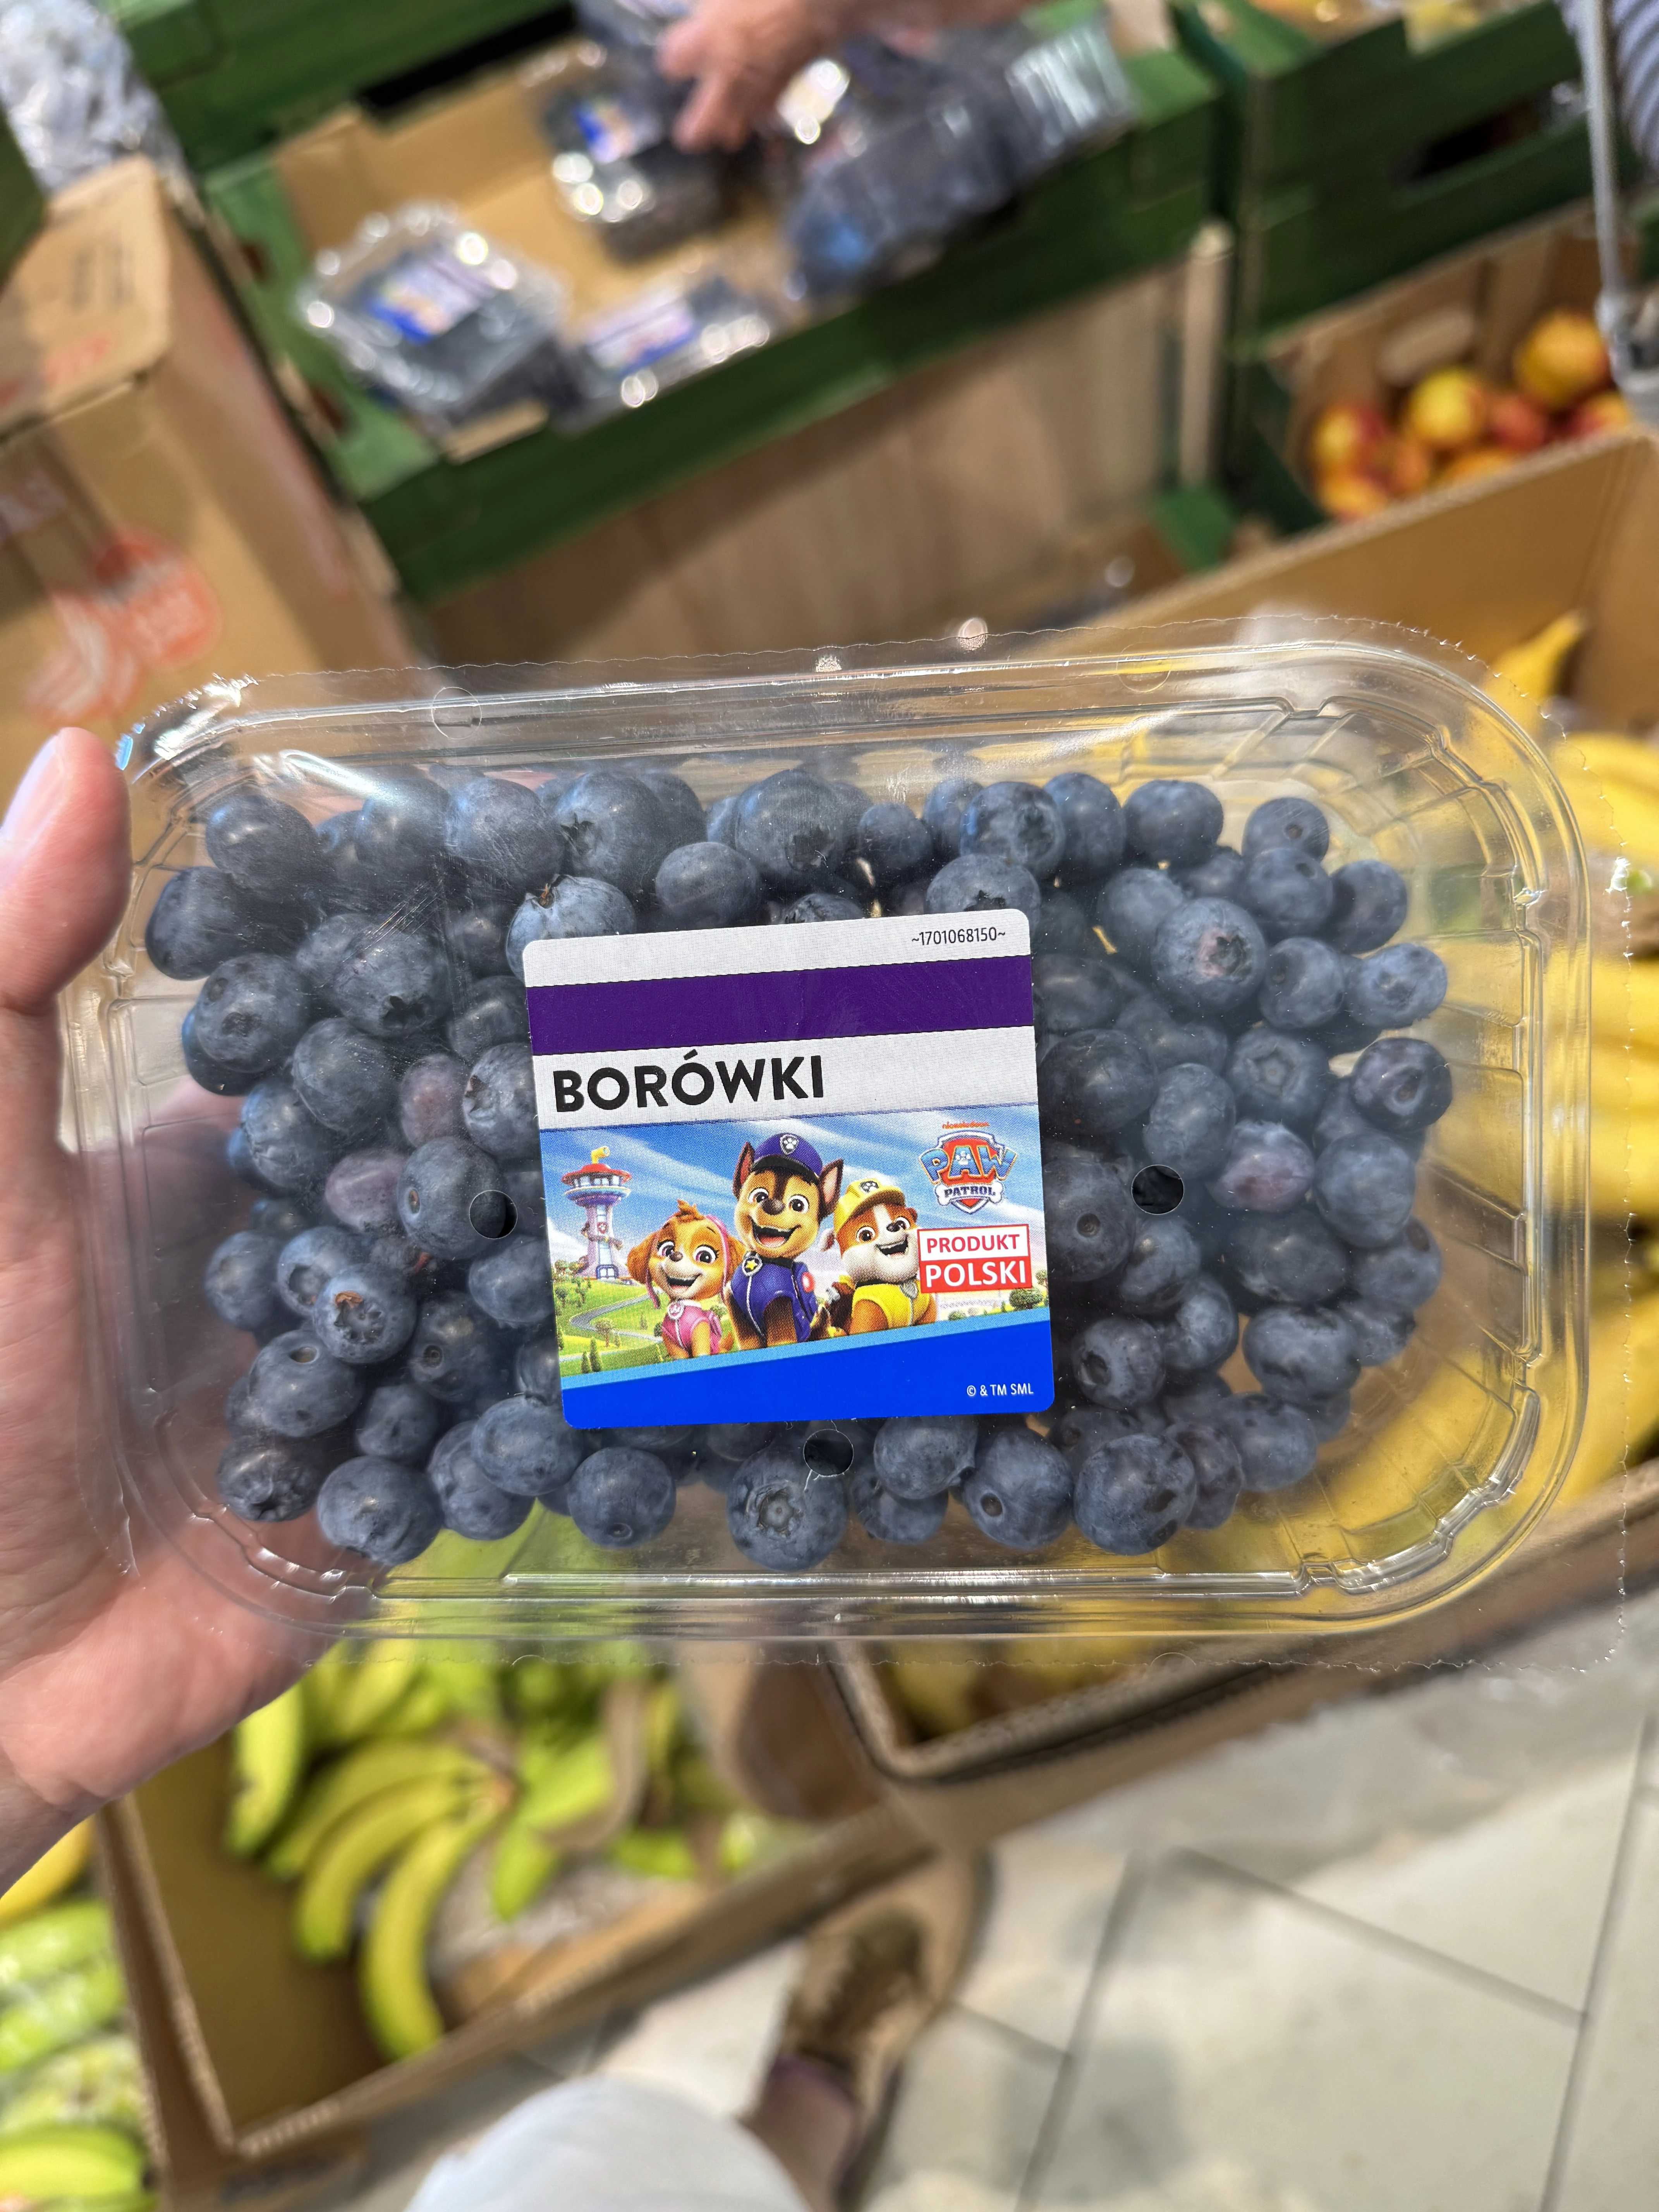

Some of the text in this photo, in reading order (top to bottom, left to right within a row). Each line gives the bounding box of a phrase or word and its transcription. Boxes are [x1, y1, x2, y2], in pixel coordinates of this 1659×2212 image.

[912, 927, 1005, 945] ~1701068150~
[553, 1049, 823, 1112] BORÓWKI
[919, 1145, 1018, 1185] PAW
[944, 1186, 996, 1197] PATROL
[927, 1234, 1019, 1253] PRODUKT
[926, 1261, 1026, 1287] POLSKI
[980, 1385, 988, 1396] &
[990, 1384, 1007, 1396] TM
[1010, 1383, 1034, 1395] SML
